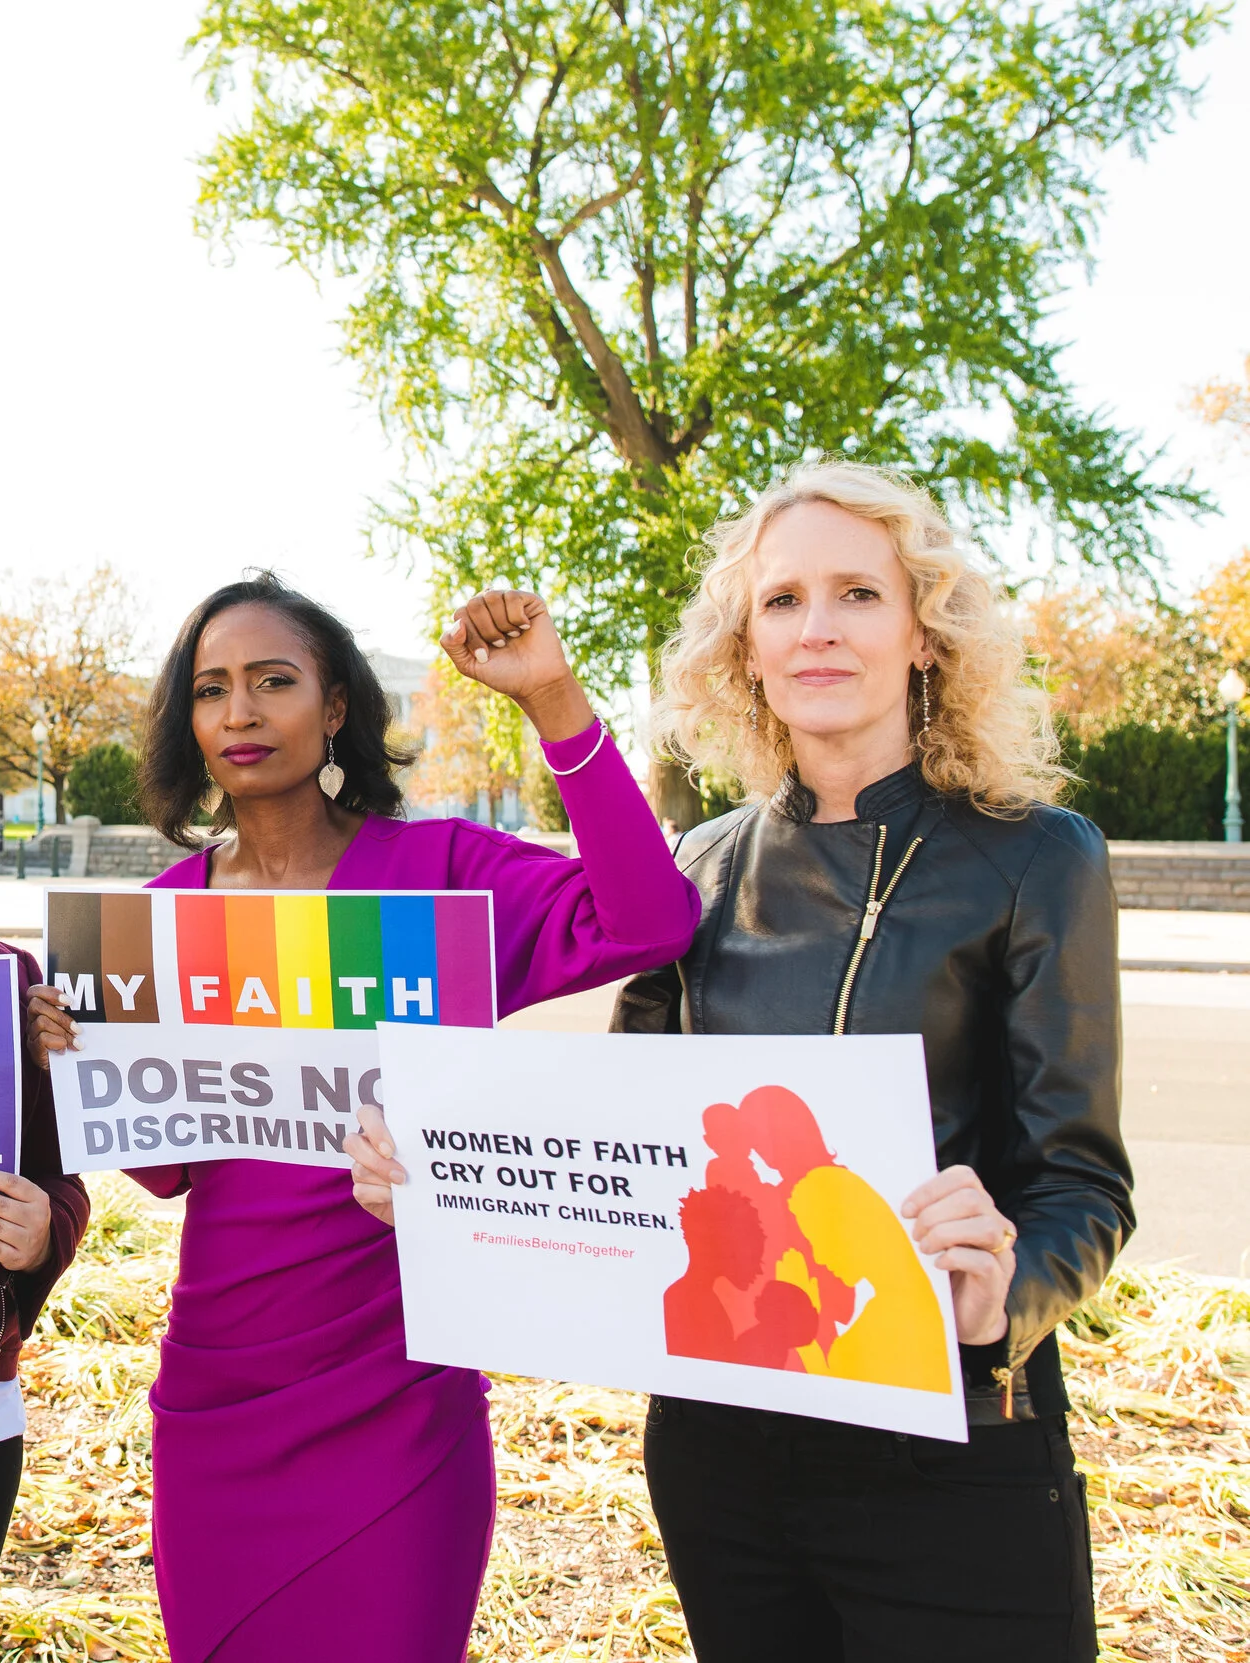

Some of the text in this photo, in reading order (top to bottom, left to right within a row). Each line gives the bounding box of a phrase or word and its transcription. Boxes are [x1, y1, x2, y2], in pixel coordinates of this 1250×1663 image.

[54, 973, 434, 1017] MY FAITH
[76, 1058, 274, 1110] DOES
[83, 1113, 364, 1156] DISCRIMIN
[422, 1128, 689, 1168] WOMEN OF FAITH
[430, 1160, 633, 1198] CRY OUT FOR
[435, 1193, 675, 1232] IMMIGRANT CHILDREN.
[472, 1231, 635, 1260] #FamiliesBelongTogether
